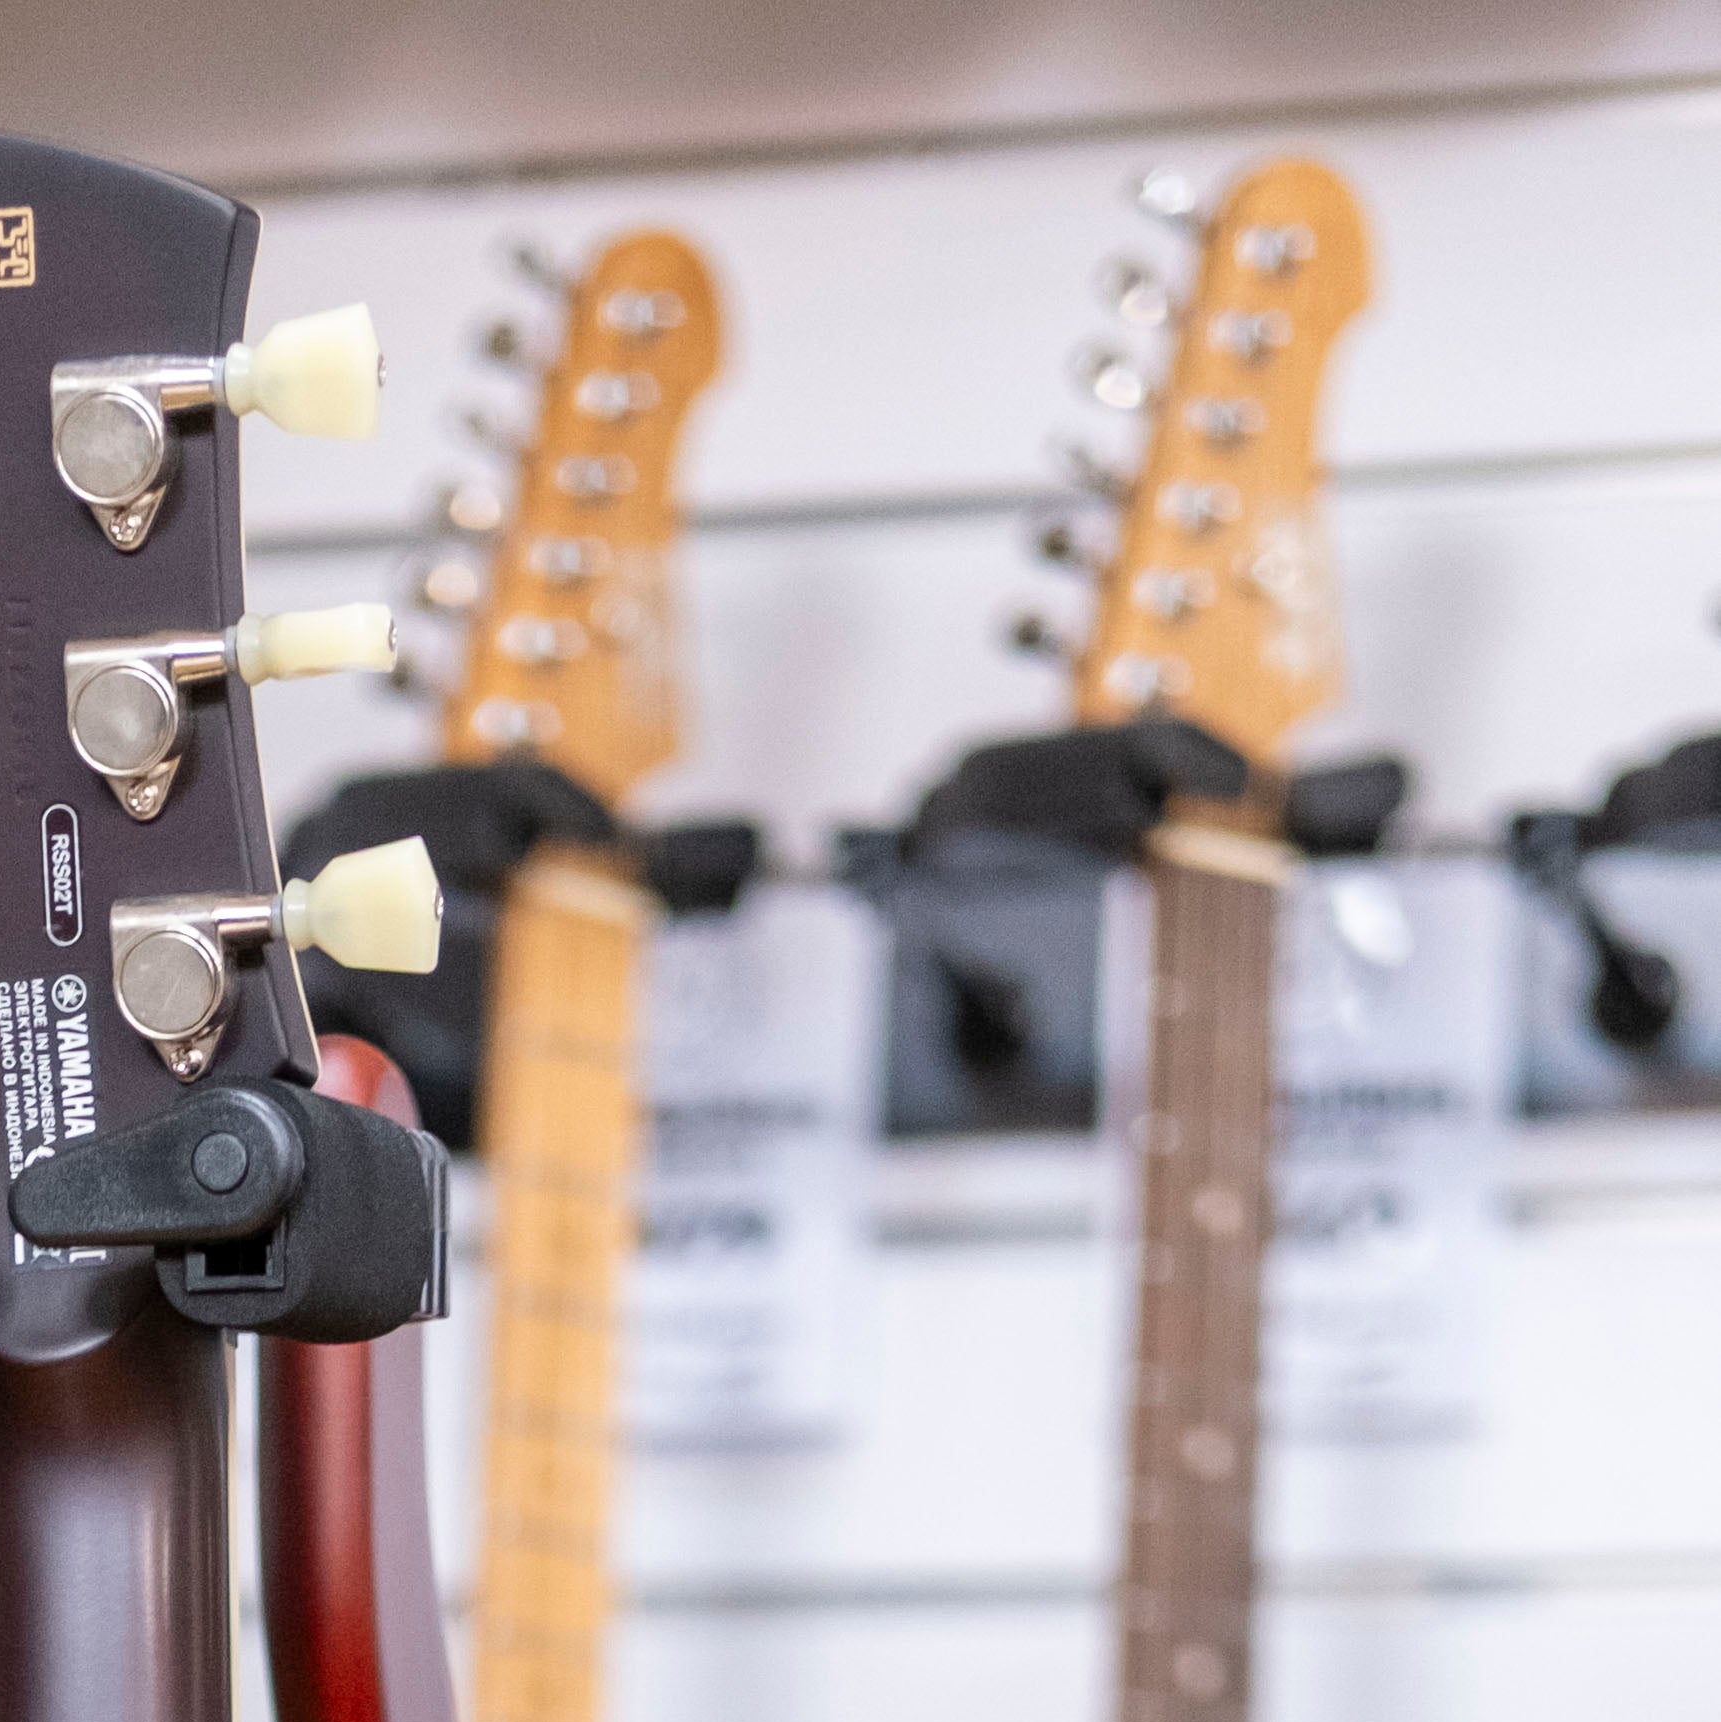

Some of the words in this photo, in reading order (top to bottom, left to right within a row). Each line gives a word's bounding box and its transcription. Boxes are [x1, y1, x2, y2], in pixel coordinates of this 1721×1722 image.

[51, 833, 73, 915] RSS02T
[30, 977, 48, 1028] MADE
[35, 1032, 50, 1051] IN
[3, 1073, 18, 1086] В
[13, 980, 39, 1131] ЭЛЕКТРОГИТАРА
[56, 1012, 96, 1139] YAMAHA
[37, 1054, 56, 1145] INDONESIA
